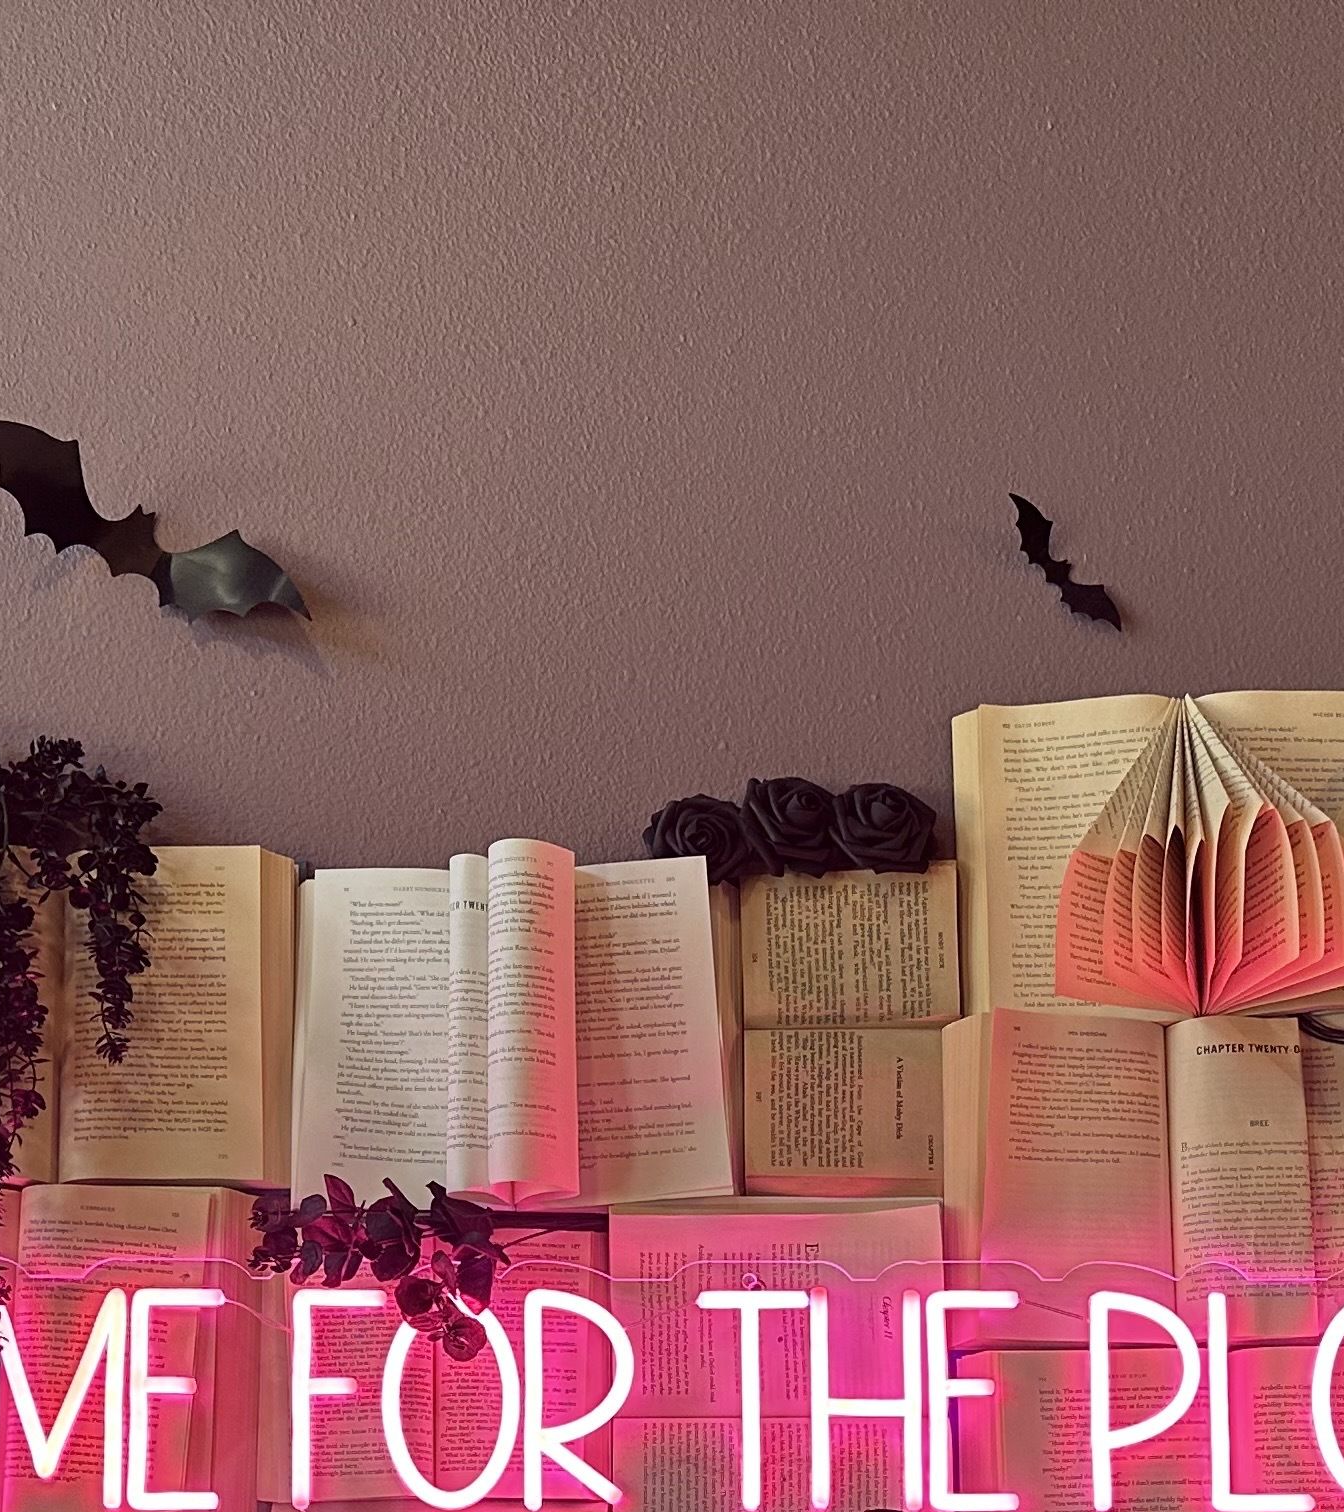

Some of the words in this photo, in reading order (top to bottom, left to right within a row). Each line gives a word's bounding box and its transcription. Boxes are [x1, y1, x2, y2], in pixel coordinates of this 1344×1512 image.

[463, 900, 488, 911] TWENT
[1196, 1043, 1245, 1055] CHAPTER
[1248, 1043, 1289, 1054] TWENTY
[895, 1100, 903, 1121] Moby
[895, 1123, 903, 1140] Dick
[880, 1296, 893, 1329] Chapter
[292, 1287, 635, 1511] FOR
[696, 1287, 1020, 1512] THE
